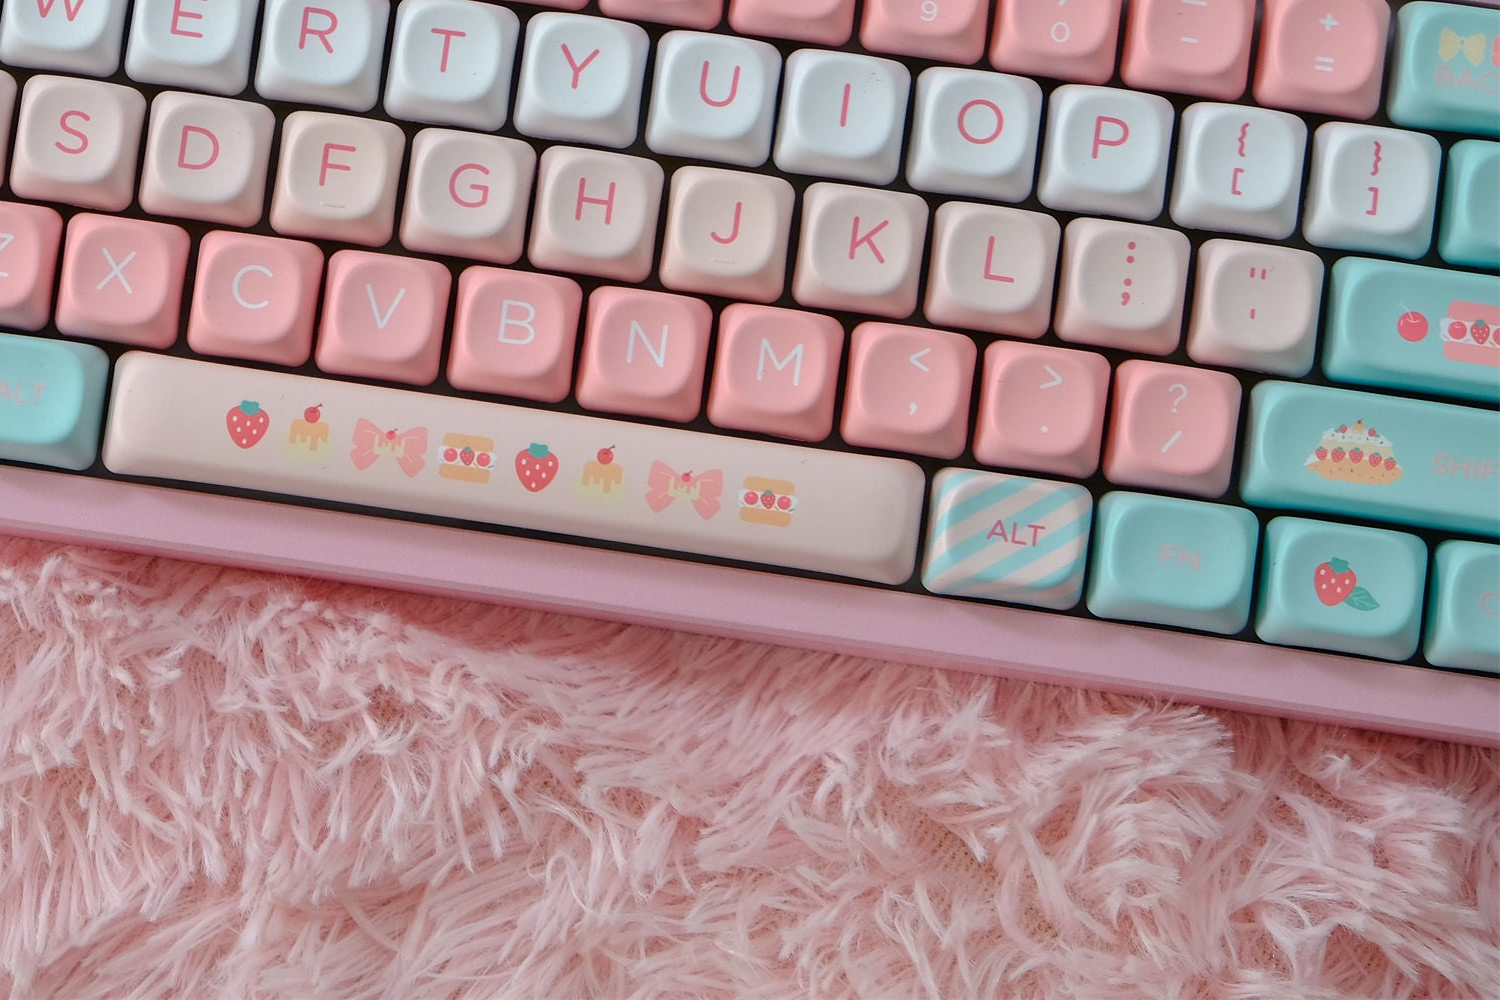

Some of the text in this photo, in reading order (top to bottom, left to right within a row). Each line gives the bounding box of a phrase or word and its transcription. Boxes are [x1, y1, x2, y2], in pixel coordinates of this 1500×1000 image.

[298, 6, 339, 54] R
[920, 0, 939, 22] 9
[430, 27, 467, 73] T
[561, 43, 601, 90] Y
[699, 60, 741, 108] U
[839, 83, 852, 128] I
[54, 109, 91, 155] S
[957, 98, 1005, 145] O
[1091, 115, 1130, 160] P
[177, 124, 220, 171] D
[318, 142, 357, 187] F
[448, 162, 491, 209] G
[575, 177, 617, 226] H
[710, 201, 743, 245] J
[848, 215, 889, 264] K
[96, 247, 137, 295] X
[983, 235, 1015, 284] L
[232, 264, 274, 310] C
[365, 283, 407, 329] V
[498, 299, 536, 346] B
[626, 320, 669, 368] N
[756, 338, 805, 387] M
[1168, 383, 1189, 414] ?
[986, 518, 1049, 548] ALT
[1159, 544, 1203, 573] FN
